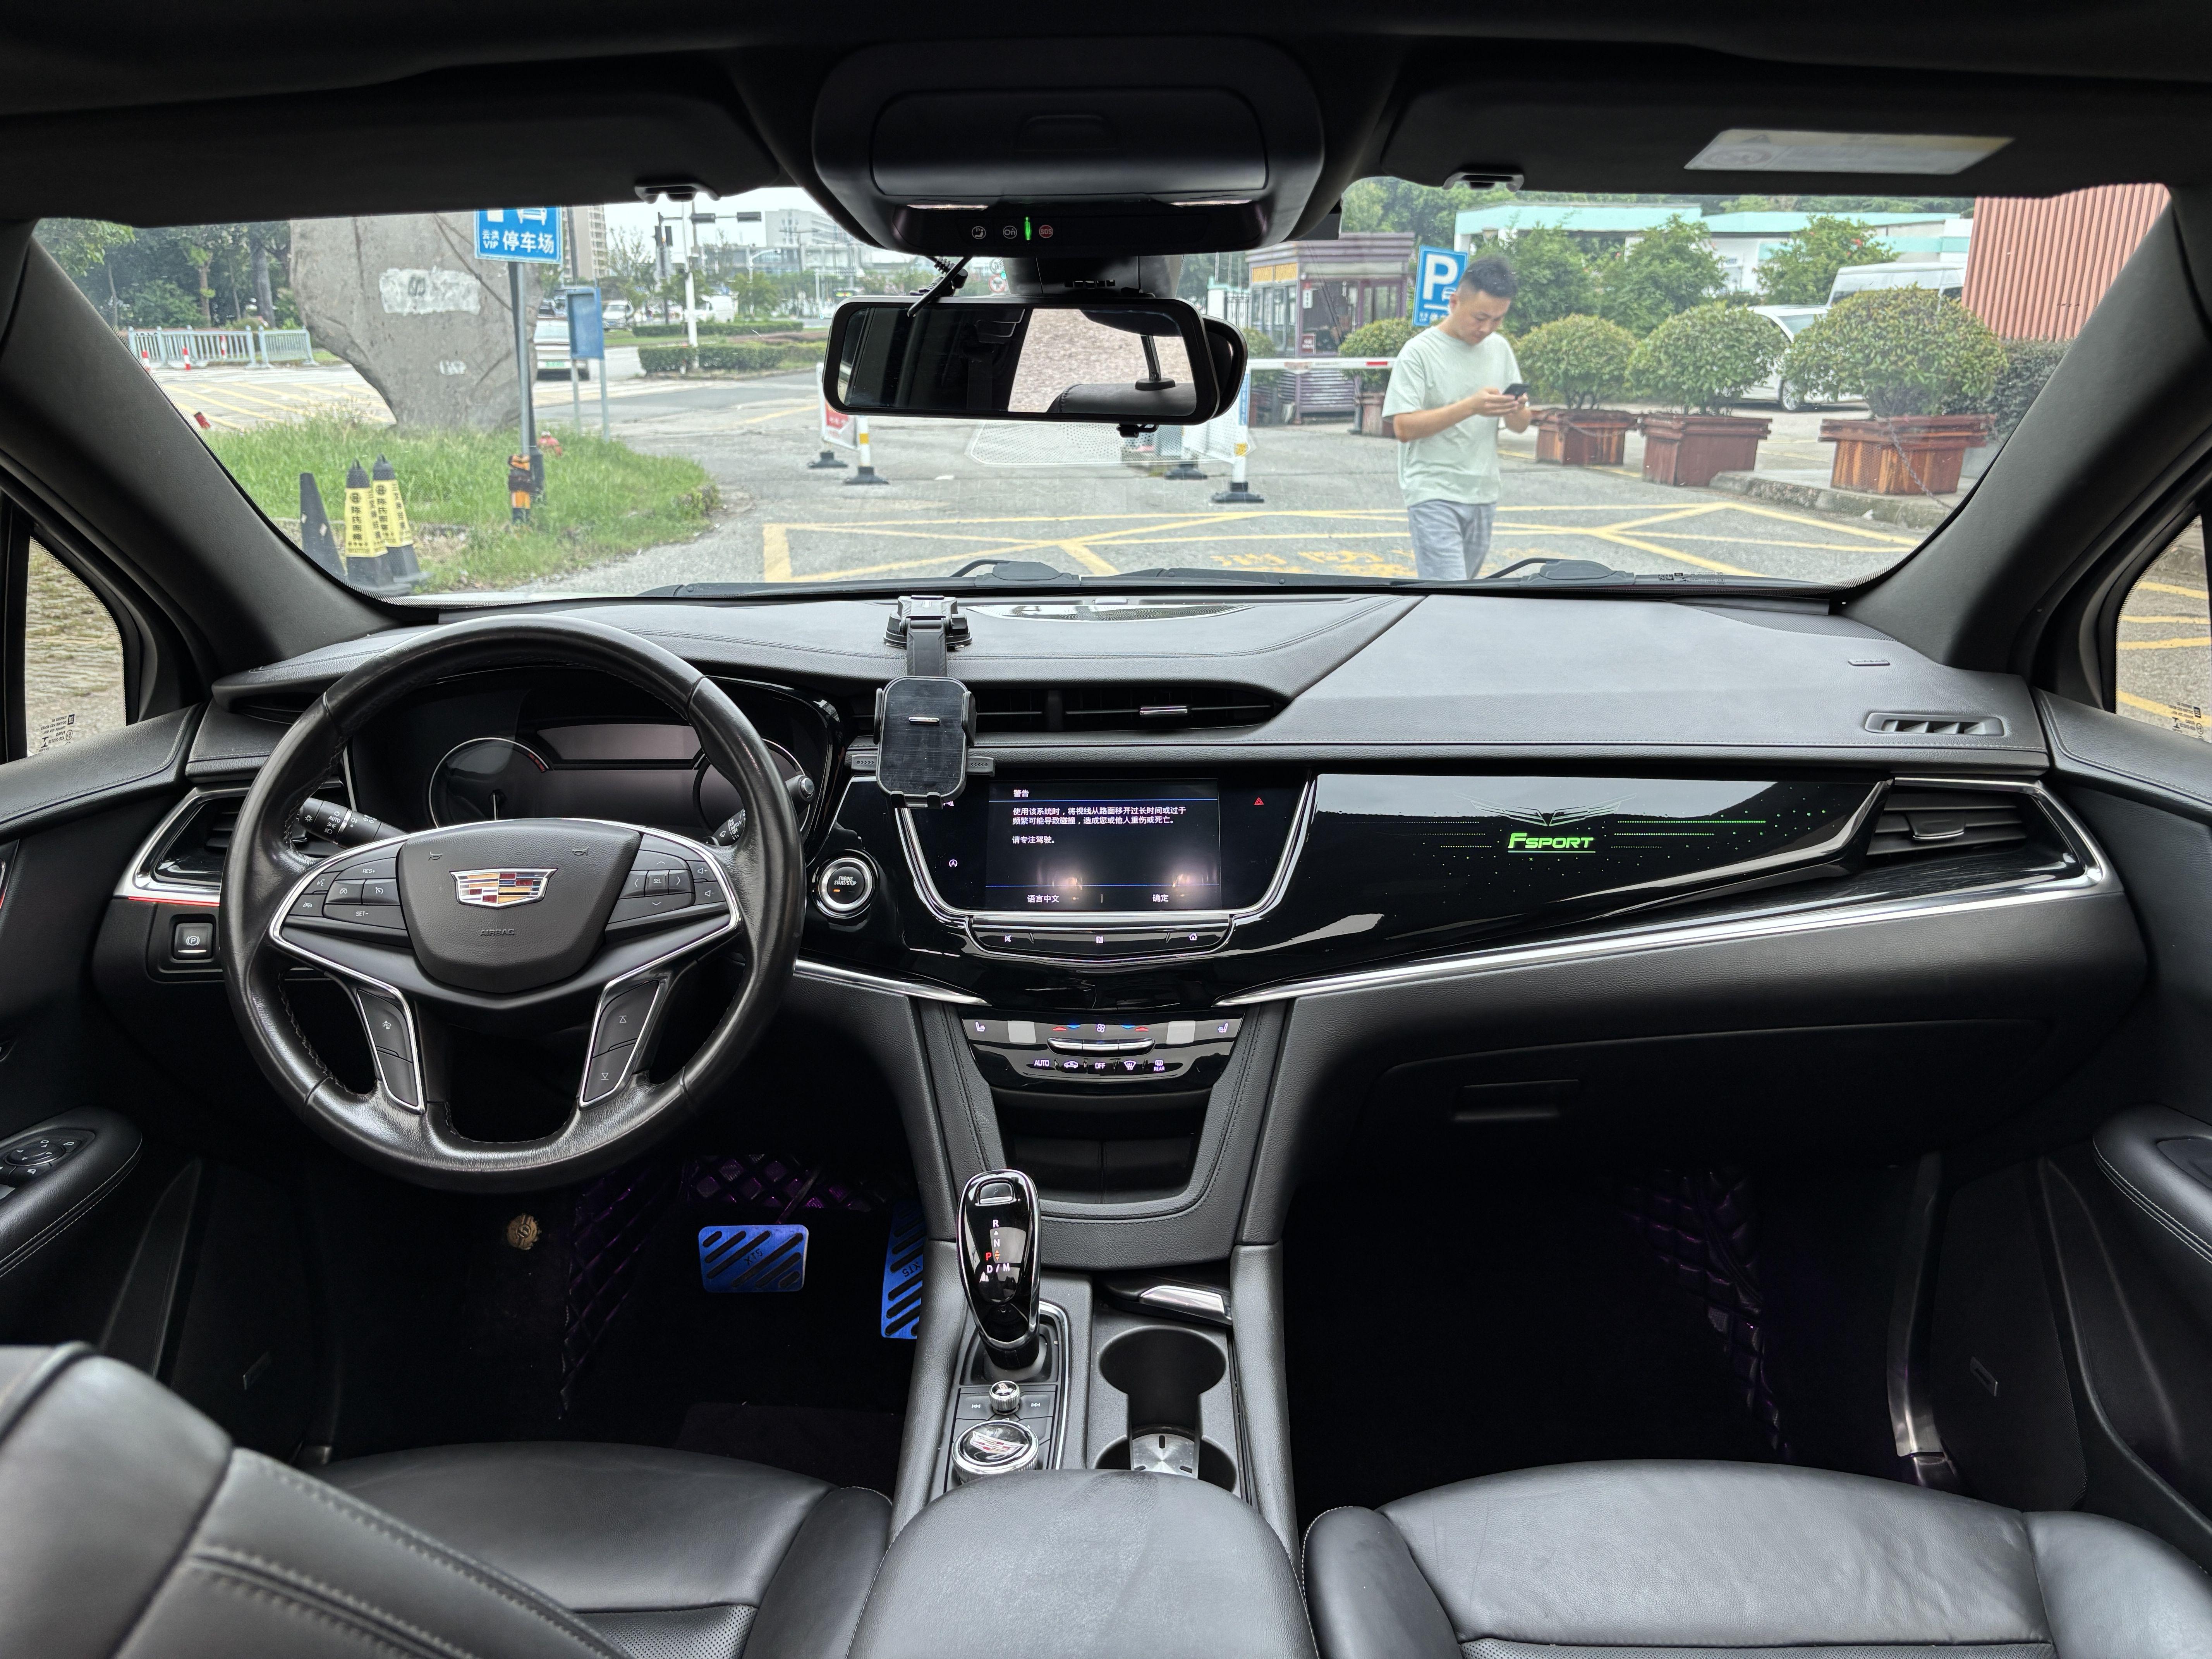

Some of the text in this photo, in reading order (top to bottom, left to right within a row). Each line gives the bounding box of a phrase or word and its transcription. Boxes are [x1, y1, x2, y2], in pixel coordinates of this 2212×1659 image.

[483, 240, 499, 249] VIP
[503, 230, 554, 254] 停车场
[1423, 254, 1458, 300] P
[1013, 789, 1029, 797] 警告
[731, 822, 739, 831] AUTO
[1012, 836, 1055, 844] 请专注驾驶。
[1027, 894, 1060, 903] 语言中文
[1152, 894, 1169, 902] 确定
[1034, 1060, 1050, 1068] AUTO
[992, 1219, 999, 1227] R
[993, 1239, 1000, 1247] N
[986, 1252, 992, 1261] P
